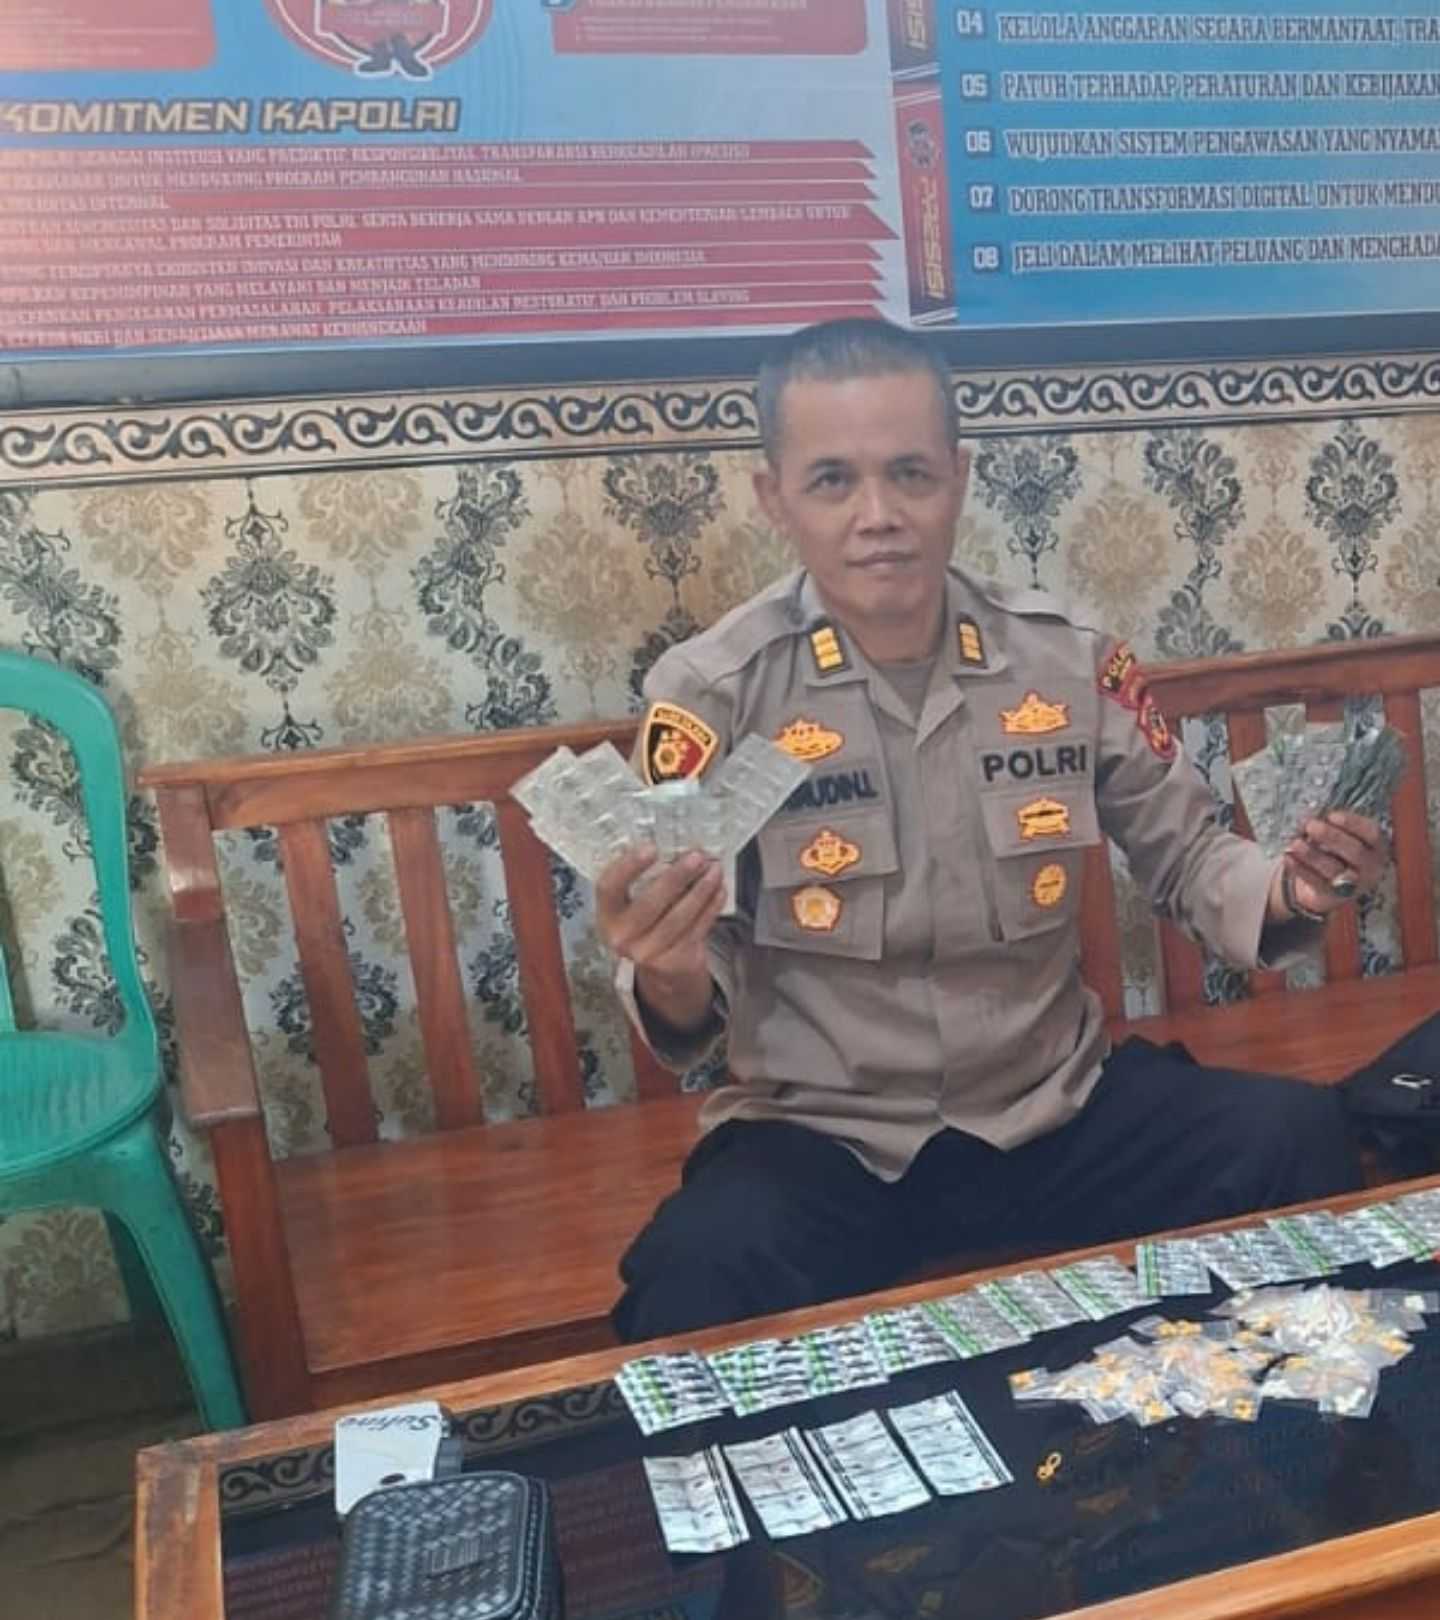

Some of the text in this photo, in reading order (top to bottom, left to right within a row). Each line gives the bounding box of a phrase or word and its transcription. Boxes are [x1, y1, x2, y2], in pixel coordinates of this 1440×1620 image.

[957, 10, 984, 34] 04
[999, 15, 1082, 41] KELOLA
[1084, 15, 1187, 41] ANGGARAN
[1193, 16, 1268, 41] SECARA
[961, 74, 988, 97] 05
[1003, 74, 1067, 98] PATUH
[1072, 74, 1178, 98] TERHADAP
[1183, 74, 1297, 97] PERATURAN
[1303, 74, 1340, 97] DAN
[0, 98, 460, 134] KOMITMEN KAPOLRI
[1006, 131, 1114, 159] WUJUDKAN
[1119, 131, 1187, 155] SISTEM
[1194, 130, 1318, 154] PENGAWASAN
[1324, 129, 1370, 152] YANG
[970, 186, 994, 209] 07
[1011, 187, 1088, 213] DORONG
[1092, 185, 1236, 211] TRANSFORMASI
[1242, 184, 1310, 209] DIGITAL
[1317, 183, 1379, 206] UNTUK
[974, 247, 999, 269] 08
[1013, 246, 1053, 271] JELI
[1059, 245, 1127, 268] DALAM
[1131, 243, 1216, 267] MELIHAT
[1221, 240, 1303, 263] PELUANG
[1309, 238, 1345, 260] DAN
[982, 745, 1086, 783] POLRI
